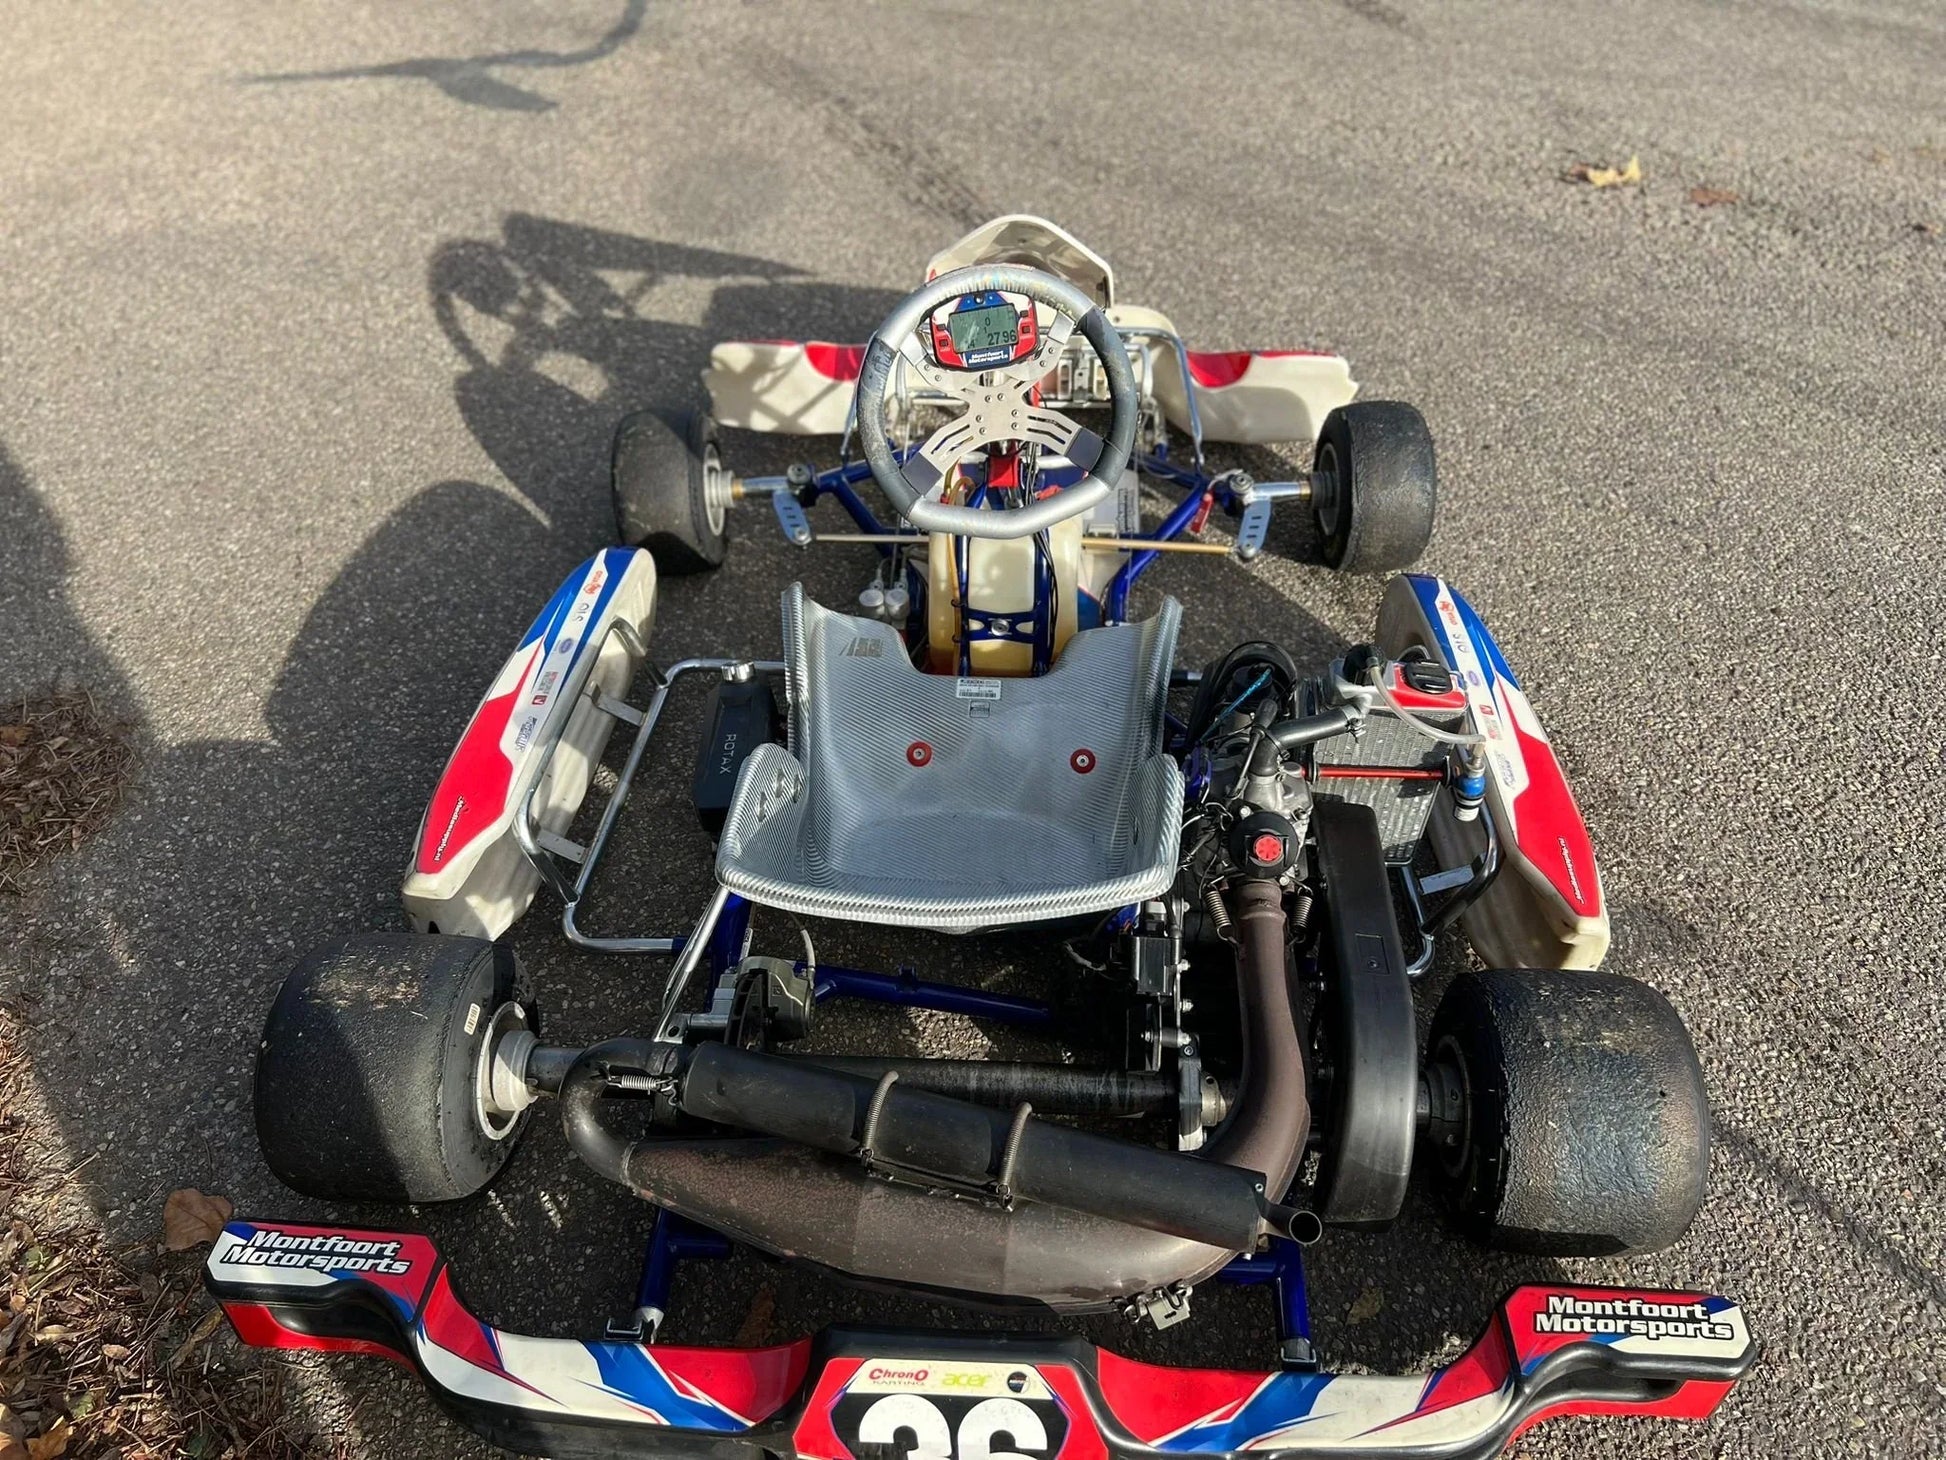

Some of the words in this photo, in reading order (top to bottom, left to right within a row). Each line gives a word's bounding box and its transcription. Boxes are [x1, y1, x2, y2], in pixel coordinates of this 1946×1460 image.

[987, 330, 1017, 345] 2796
[720, 734, 737, 774] ROTAX
[247, 1230, 401, 1256] Montfoort
[222, 1246, 411, 1274] Motorsports
[1548, 1296, 1708, 1320] Montfoort
[1536, 1313, 1732, 1338] Motorsports
[942, 1373, 990, 1387] acer
